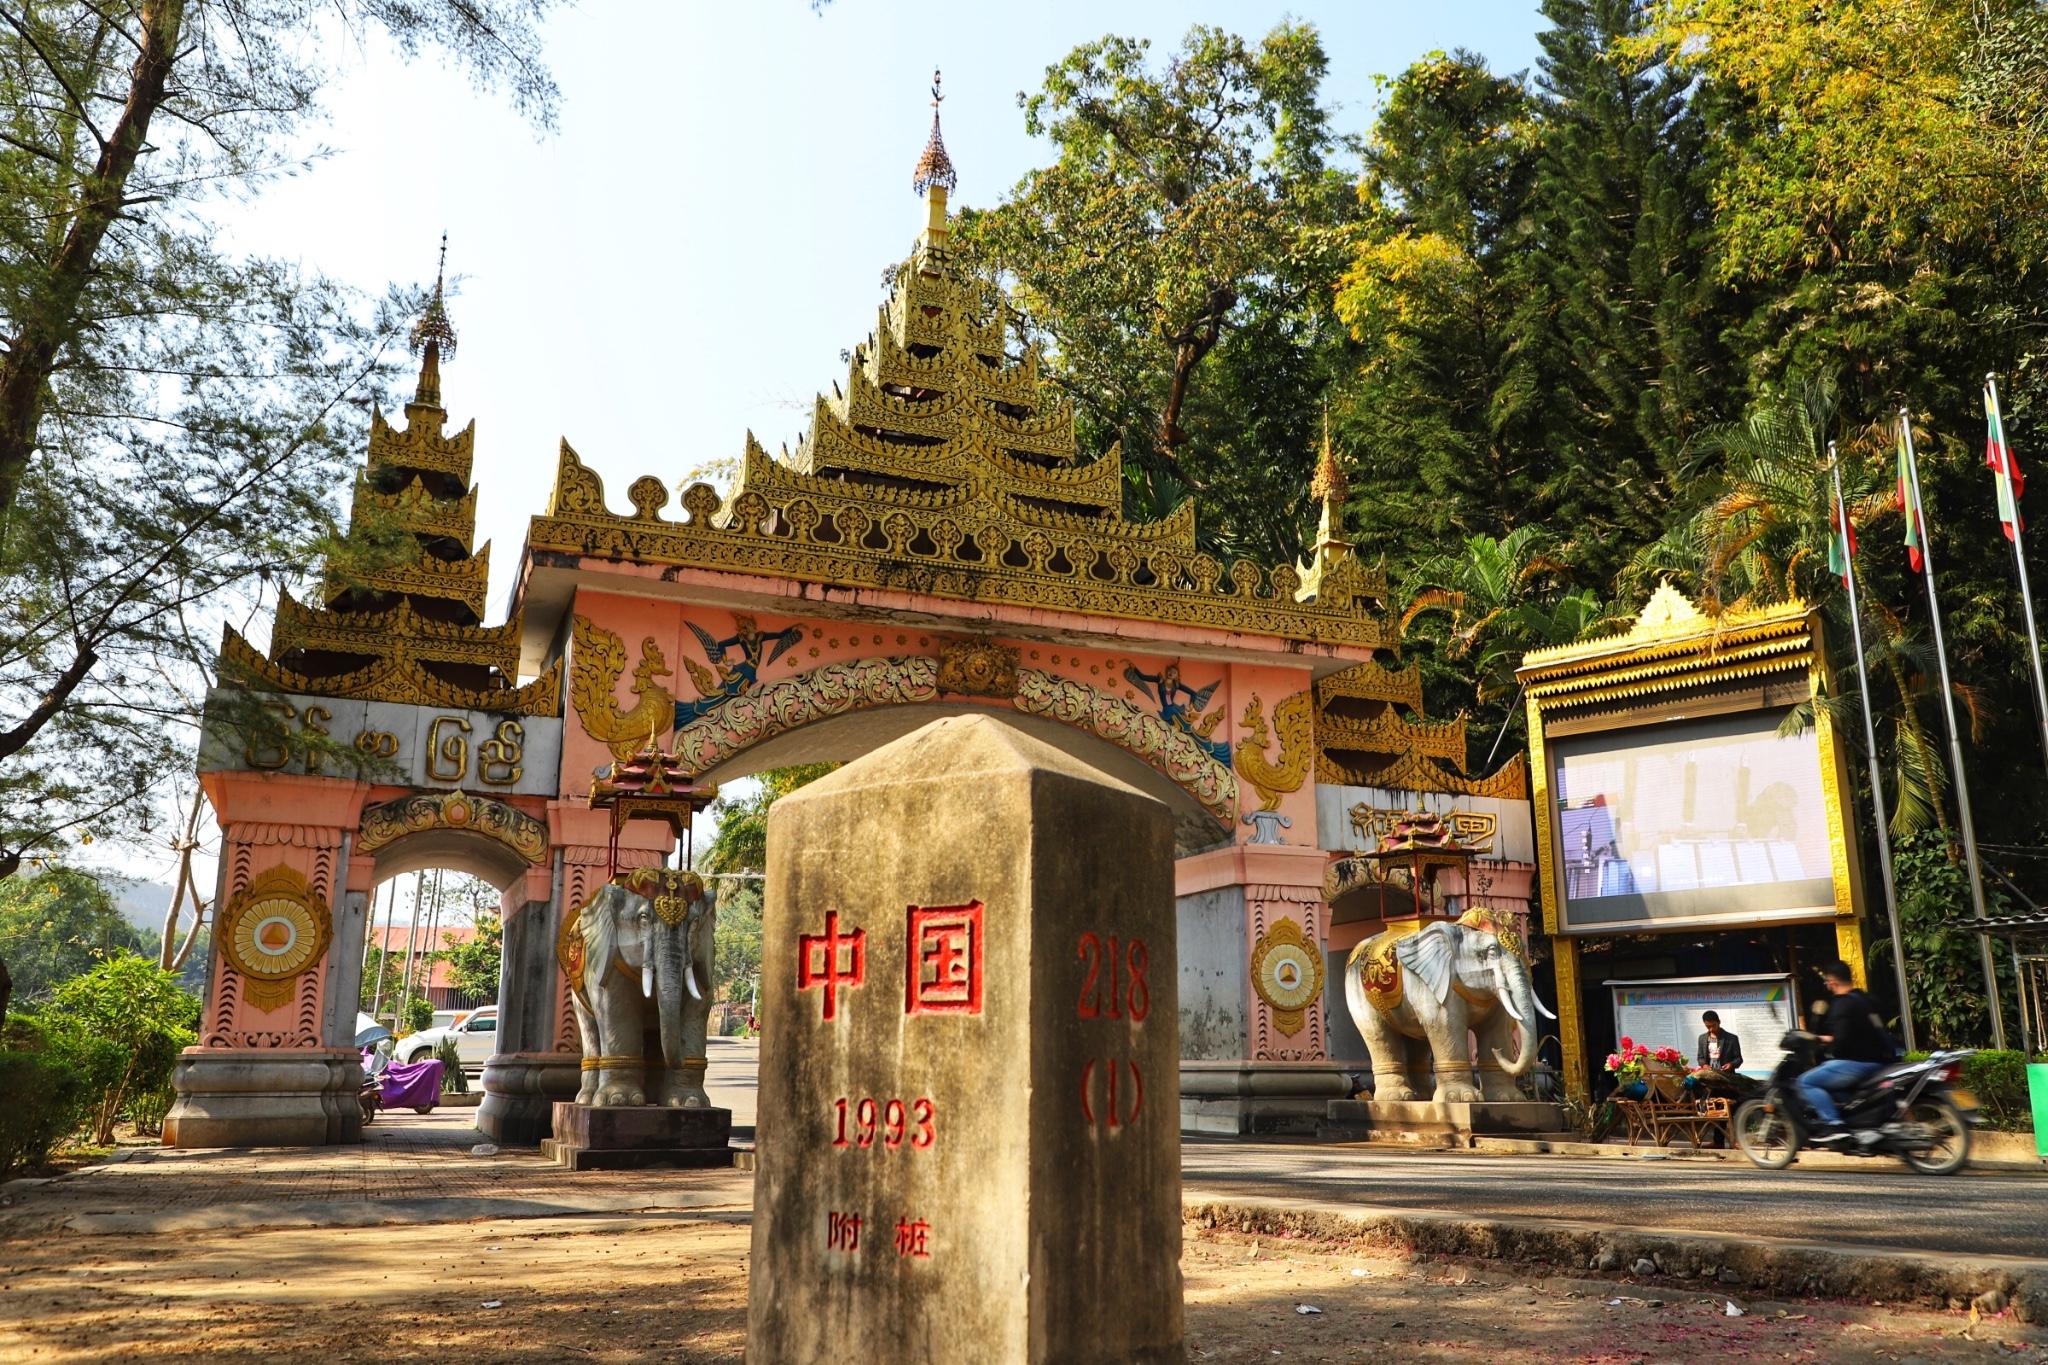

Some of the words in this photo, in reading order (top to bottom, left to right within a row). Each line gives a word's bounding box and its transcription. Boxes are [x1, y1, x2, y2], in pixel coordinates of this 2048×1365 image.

[798, 898, 984, 1022] 中国
[1077, 931, 1150, 1022] 218
[832, 1096, 936, 1150] 1993
[1079, 1057, 1144, 1127] (1)
[827, 1211, 932, 1259] 附桩
